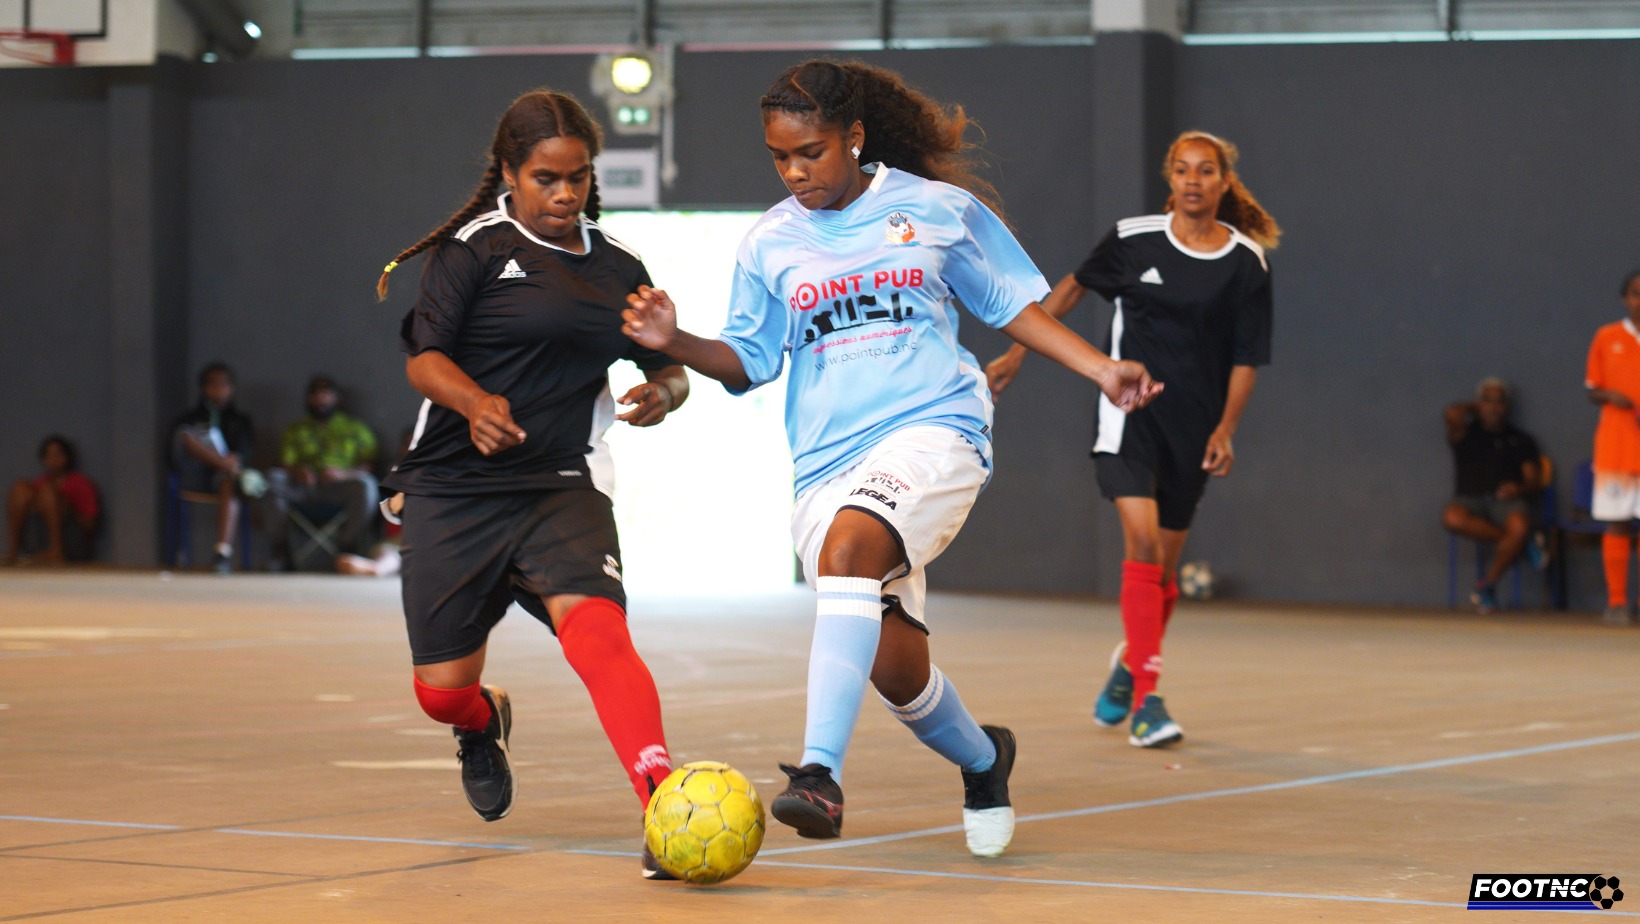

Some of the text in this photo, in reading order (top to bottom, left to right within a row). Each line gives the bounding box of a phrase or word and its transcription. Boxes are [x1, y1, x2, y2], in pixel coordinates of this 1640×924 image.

[789, 268, 924, 313] POINT PUB
[894, 478, 911, 492] PUB
[849, 487, 897, 511] LEGEA
